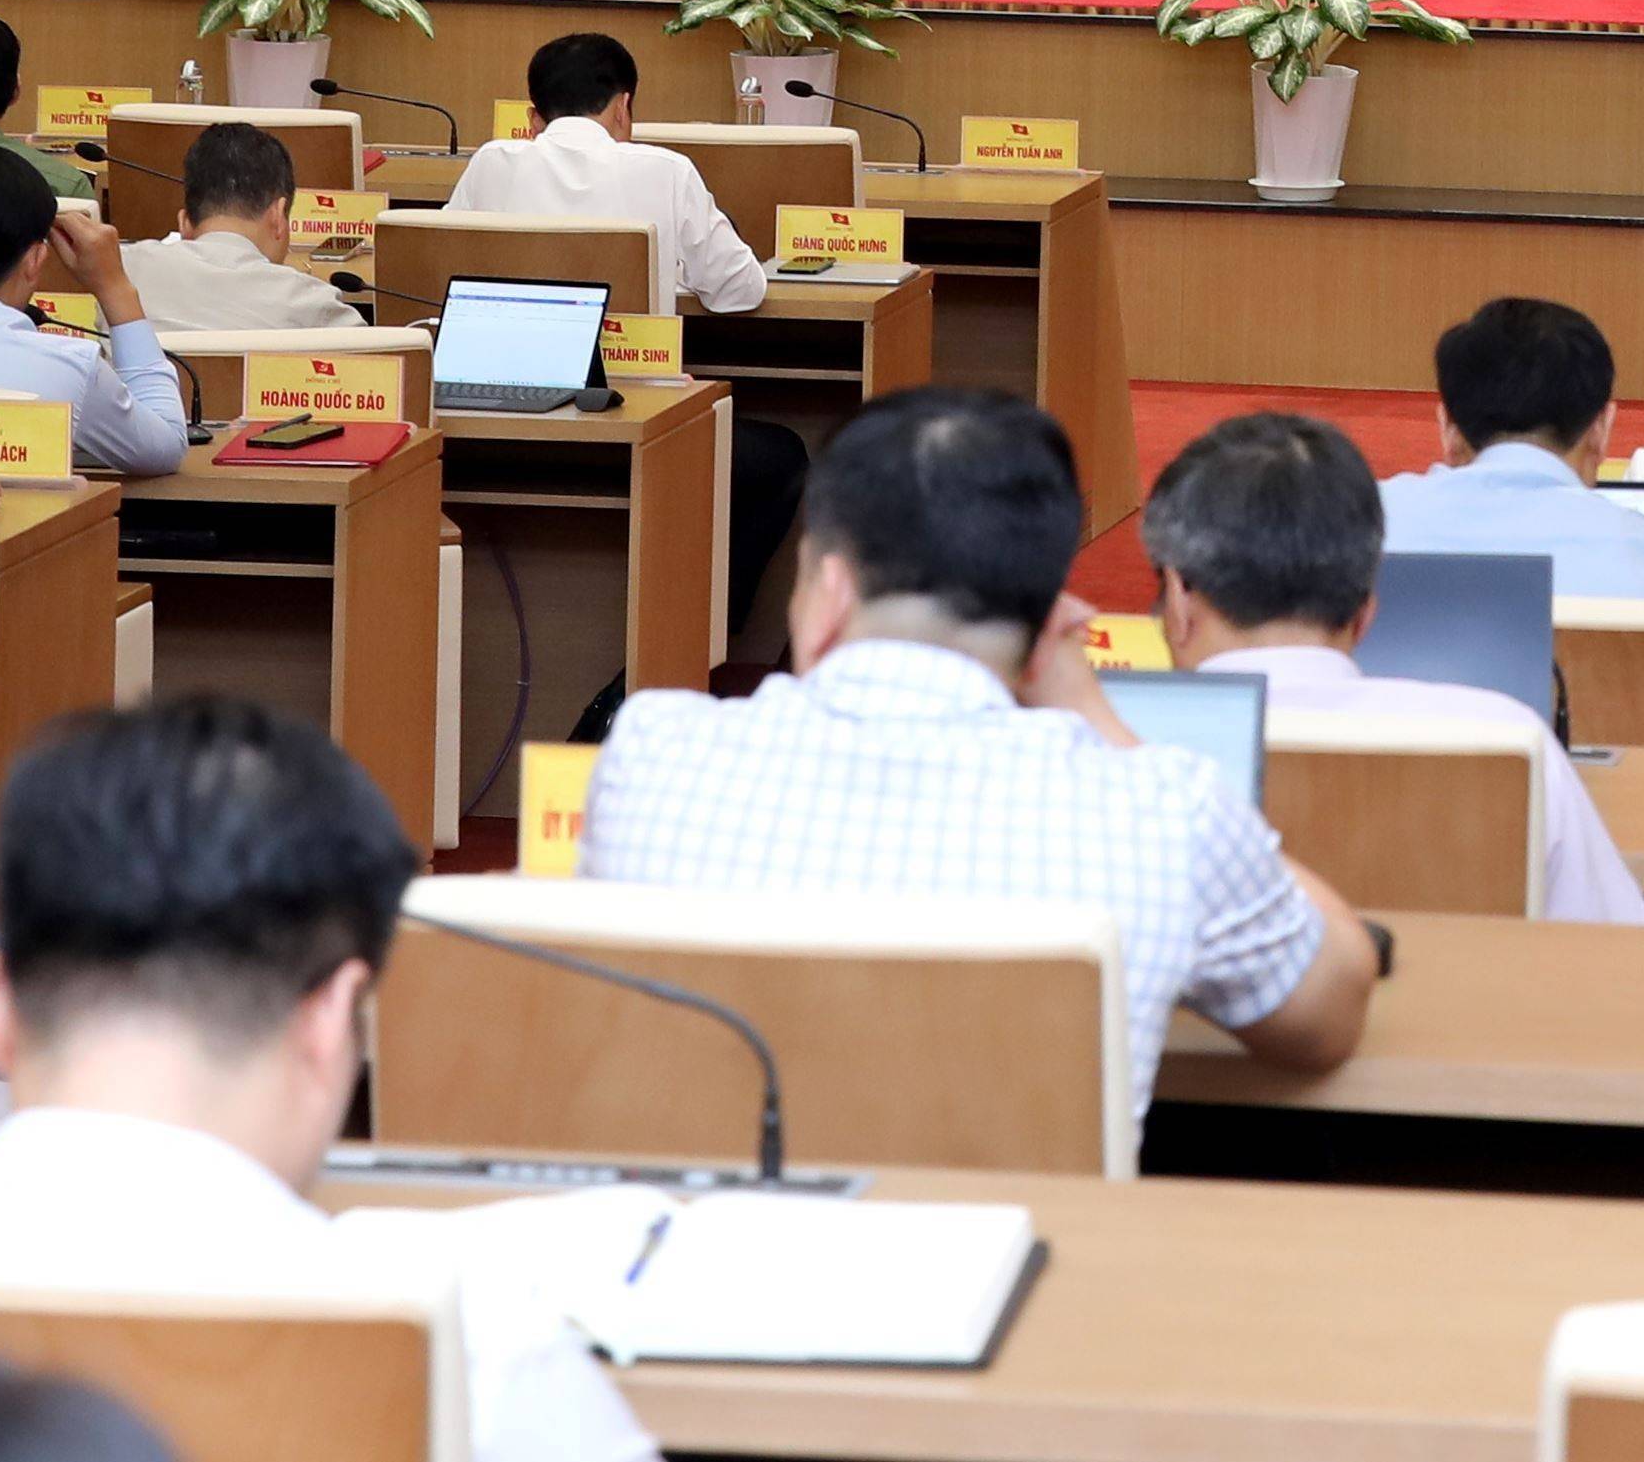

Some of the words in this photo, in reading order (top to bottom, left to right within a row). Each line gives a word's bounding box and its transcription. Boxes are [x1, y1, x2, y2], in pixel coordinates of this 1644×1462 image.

[1044, 149, 1062, 160] ANH
[302, 221, 332, 233] MINH
[827, 237, 855, 252] QUỐC
[642, 349, 669, 363] SINH
[260, 388, 308, 406] HOÀNG
[313, 387, 351, 410] QUỐC
[356, 389, 384, 411] BẢO
